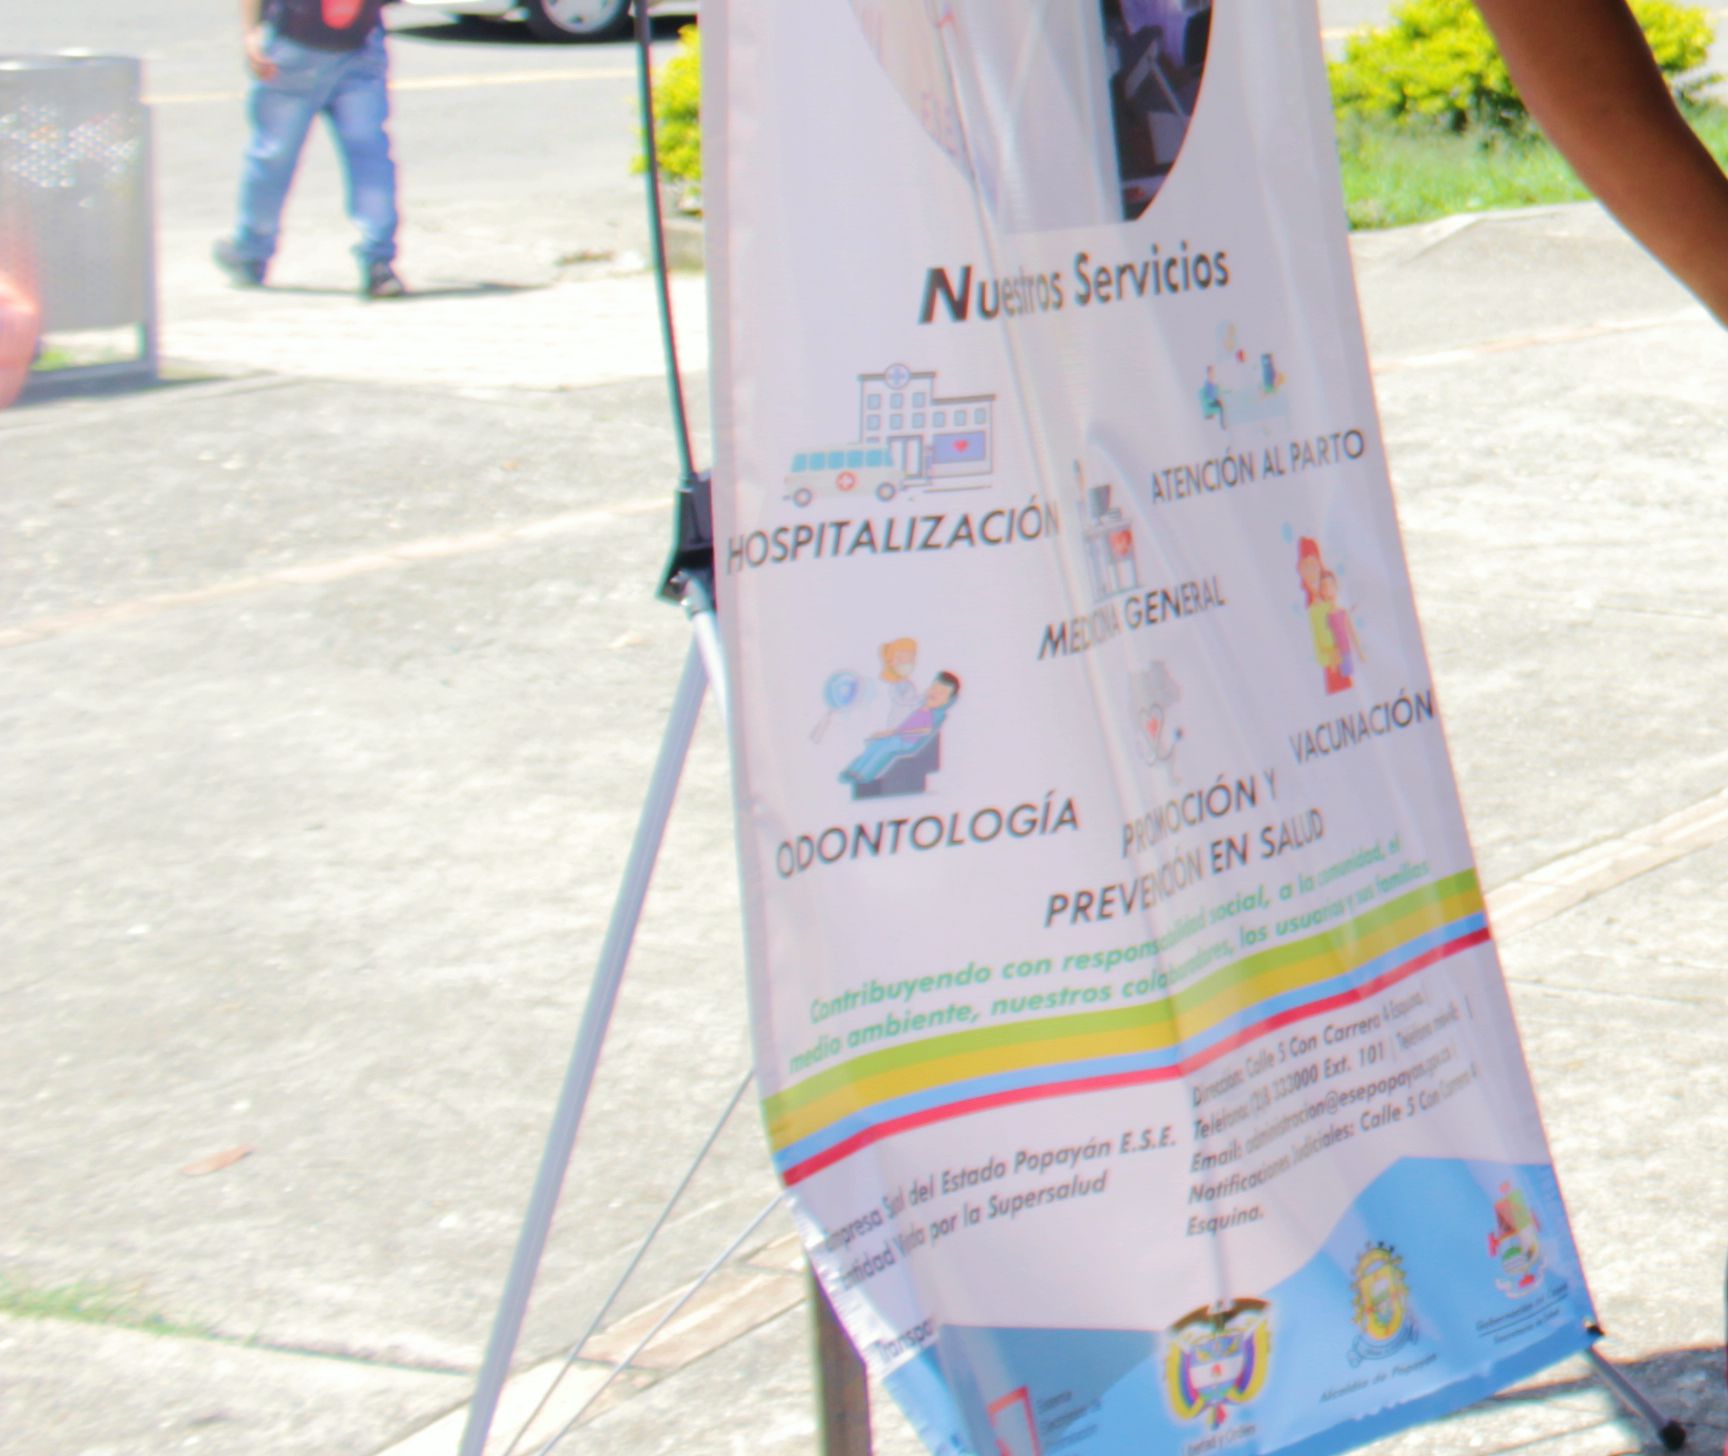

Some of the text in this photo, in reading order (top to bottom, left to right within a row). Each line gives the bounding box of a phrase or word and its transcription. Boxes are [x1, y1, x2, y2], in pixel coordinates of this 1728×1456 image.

[917, 241, 1230, 325] Nuestros Servicios
[1151, 428, 1366, 504] ATENCIÓN AL PARTO
[726, 494, 1061, 575] HOSPITALIZACIÓN
[1122, 575, 1227, 630] GENERAL
[1289, 687, 1435, 763] VACUNACIÓN
[775, 789, 1080, 879] ODONTOLOGÍA
[1122, 769, 1279, 859] PROMOCIÓN Y
[1210, 833, 1250, 876] EN
[1260, 808, 1325, 861] SALUD
[808, 960, 993, 1026] Contribuyendo
[1001, 954, 1054, 981] con
[1208, 882, 1272, 923] social,
[1278, 883, 1294, 901] a
[1298, 870, 1315, 894] la
[788, 1034, 842, 1076] medio
[847, 1000, 981, 1050] ambiente,
[990, 980, 1113, 1017] nuestros
[1239, 923, 1269, 947] los
[1288, 1034, 1318, 1059] Con
[1322, 1014, 1381, 1046] Carrera
[1322, 1054, 1352, 1080] Ext.
[1358, 1040, 1386, 1069] 101
[1359, 1101, 1403, 1133] Calle
[909, 1173, 936, 1208] del
[941, 1155, 1008, 1196] Estado
[1013, 1135, 1113, 1176] Popayán
[1118, 1124, 1178, 1156] E.S.E.
[1189, 1139, 1243, 1174] Email:
[962, 1201, 982, 1228] la
[986, 1169, 1110, 1222] Supersalud
[1186, 1203, 1264, 1238] Esquina.
